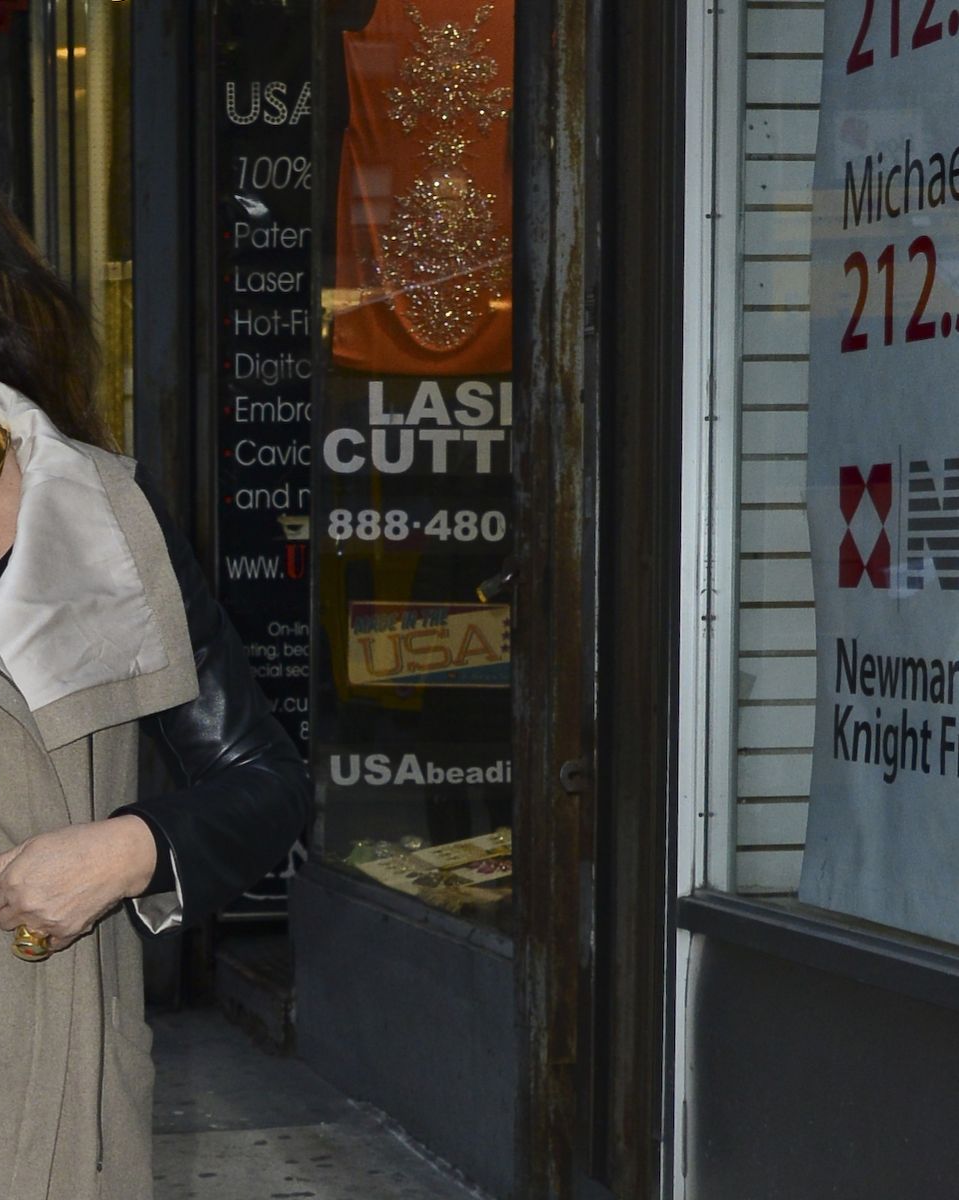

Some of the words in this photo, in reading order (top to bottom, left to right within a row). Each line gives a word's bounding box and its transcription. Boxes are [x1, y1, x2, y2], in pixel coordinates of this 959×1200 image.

[225, 81, 312, 125] USA
[234, 265, 304, 293] Laser
[841, 235, 959, 353] 212.
[322, 428, 513, 475] CUTT
[234, 483, 290, 510] and
[357, 624, 503, 677] USA
[833, 704, 932, 784] Knight
